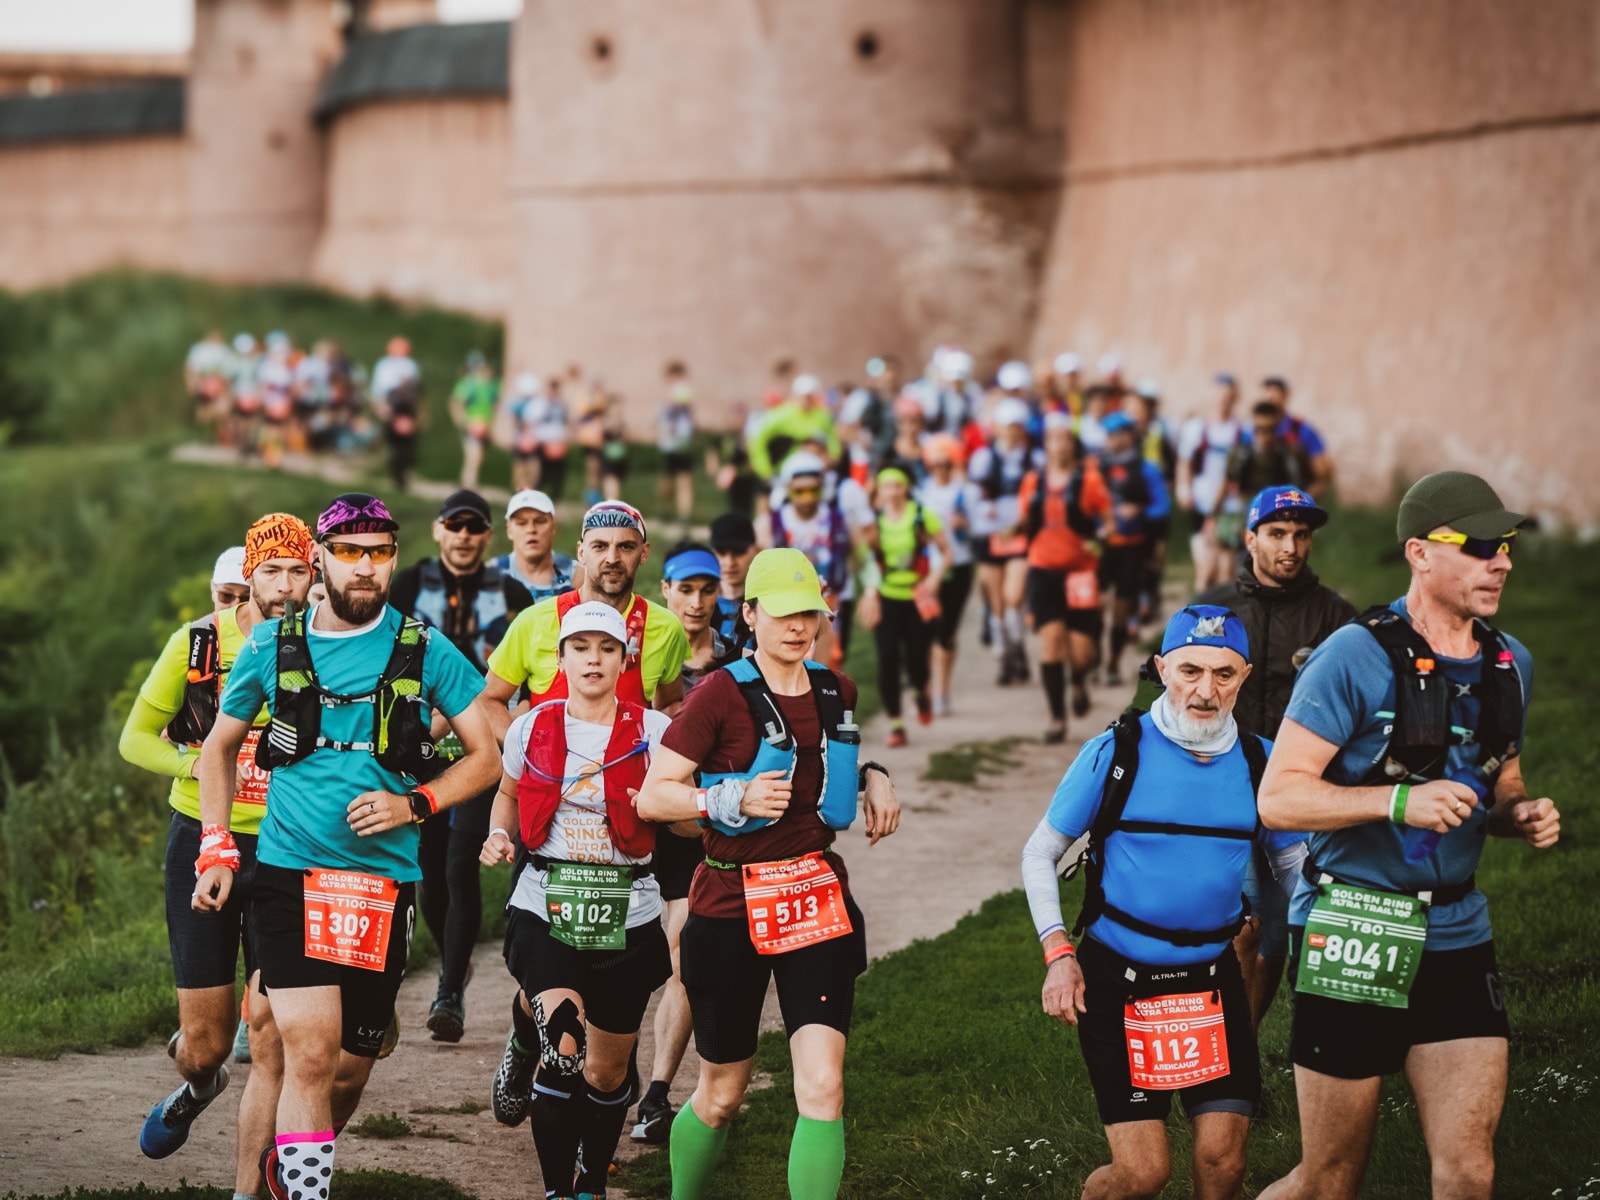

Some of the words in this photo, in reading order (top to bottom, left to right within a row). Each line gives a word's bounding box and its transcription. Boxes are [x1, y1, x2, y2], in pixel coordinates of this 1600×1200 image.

[563, 817, 602, 826] GOLDE
[564, 827, 608, 840] RING
[566, 841, 609, 851] ULTRA
[567, 851, 611, 863] TRAIL
[560, 868, 596, 877] GOLDEN
[759, 864, 797, 874] GOLDEN
[320, 873, 360, 883] GOLDEN
[362, 877, 384, 888] RING
[560, 874, 582, 882] ULTRA
[760, 873, 787, 881] ULTRA
[319, 880, 346, 889] ULTRA
[348, 883, 369, 892] TRAIL
[780, 882, 811, 897] T100
[576, 890, 600, 899] T80
[1331, 888, 1380, 905] GOLDEN
[1383, 897, 1413, 911] RING
[336, 898, 367, 910] T100
[775, 895, 819, 924] 513
[1330, 896, 1361, 910] ULTRA
[1363, 903, 1393, 916] TRAIL
[1394, 909, 1412, 918] 100
[560, 902, 612, 924] 8102
[328, 912, 370, 938] 309
[779, 919, 819, 934] ЕКАТЕРИНА
[1350, 919, 1384, 936] T80
[336, 937, 360, 946] СЕРГЕЙ
[1324, 934, 1399, 973] 8041
[1151, 972, 1188, 980] ULTRA-TRI
[1341, 967, 1376, 980] СЕРГЕЙ
[1134, 999, 1176, 1010] GOLDEN
[1178, 996, 1204, 1006] RING
[1163, 1006, 1188, 1014] TRAIL
[1189, 1004, 1205, 1012] 100
[1154, 1022, 1189, 1034] T100
[1152, 1036, 1200, 1062] 112
[1154, 1059, 1200, 1071] АЛЕКСАНДР
